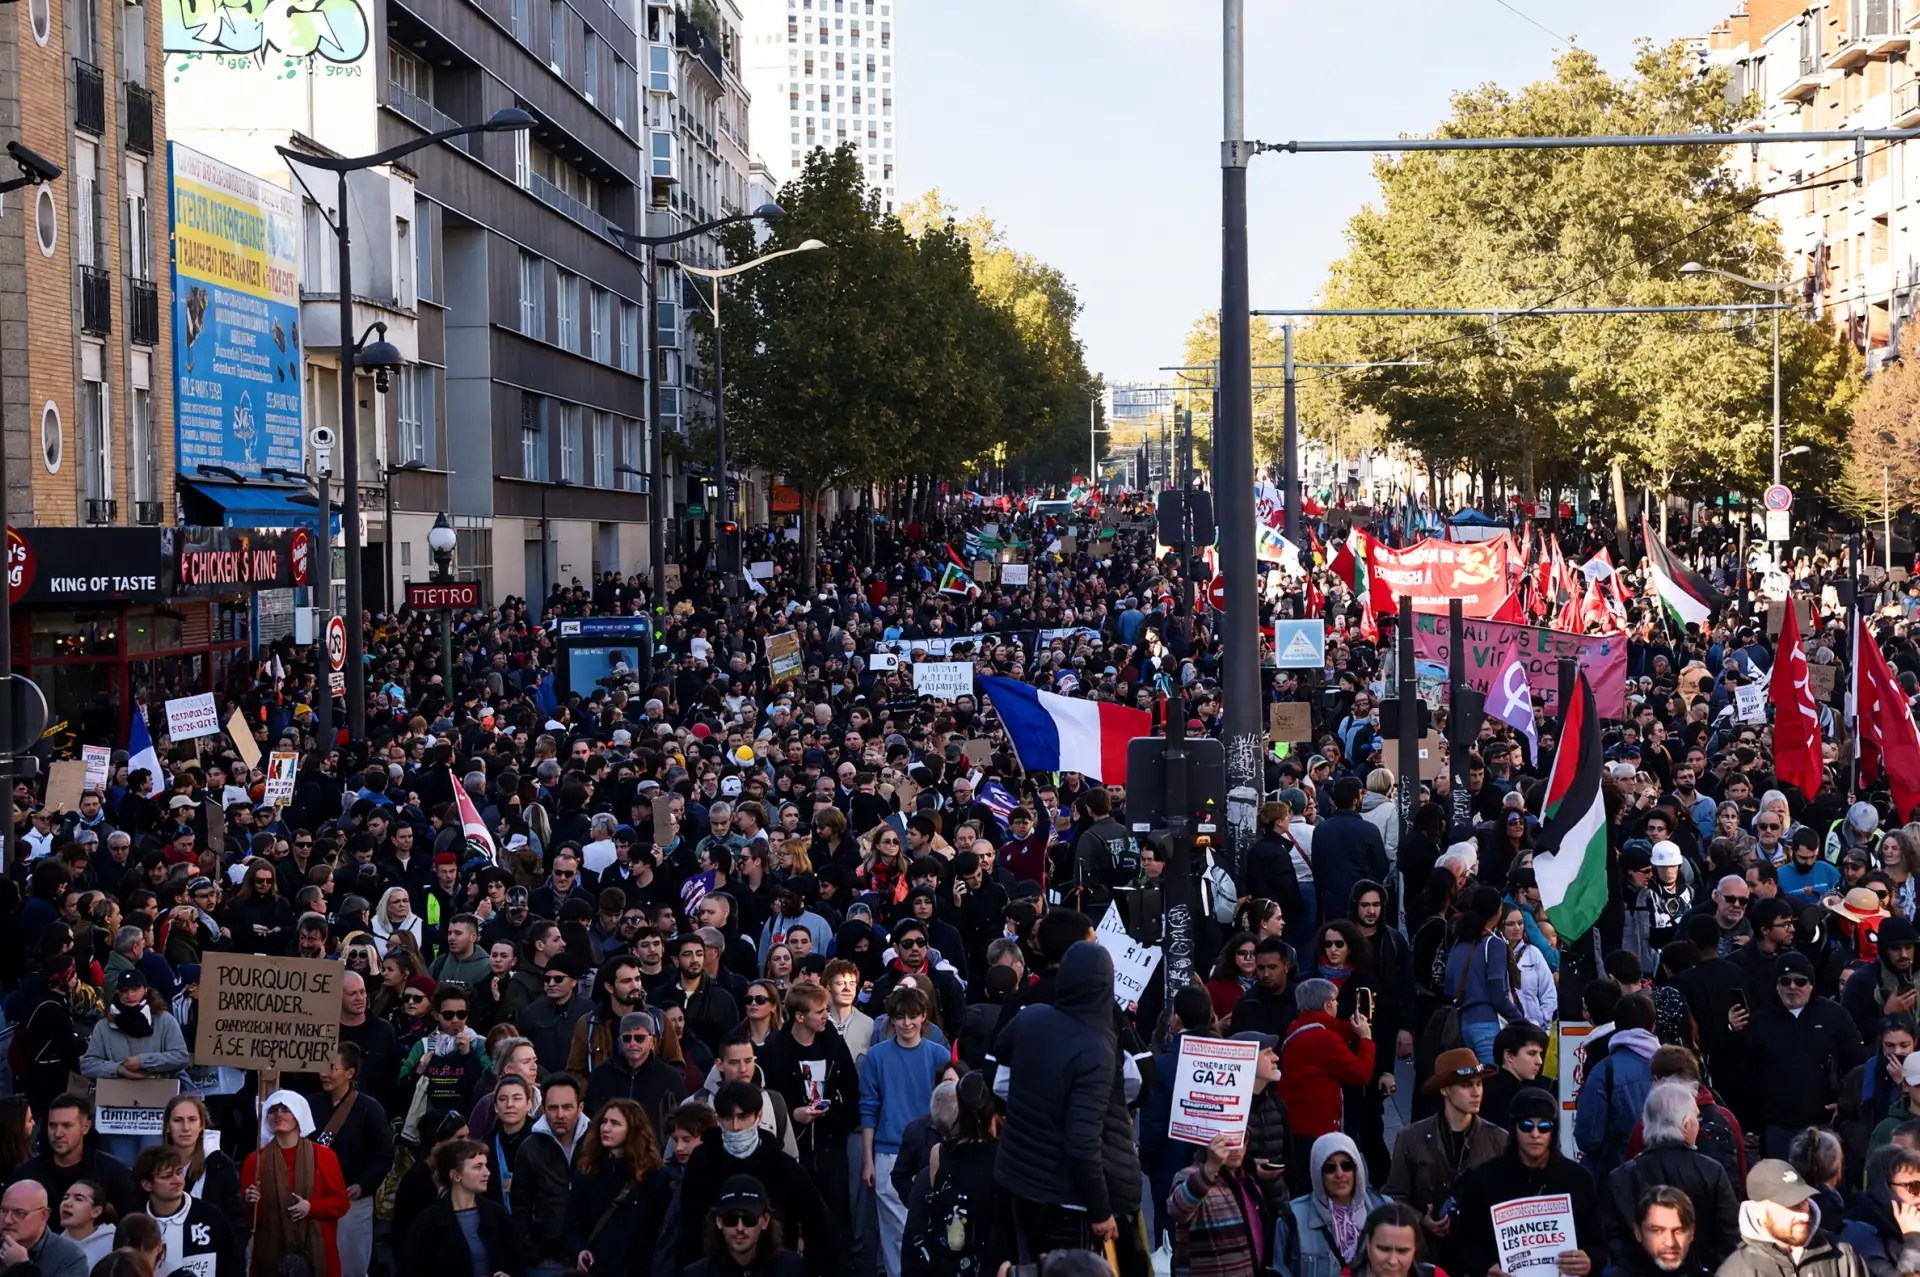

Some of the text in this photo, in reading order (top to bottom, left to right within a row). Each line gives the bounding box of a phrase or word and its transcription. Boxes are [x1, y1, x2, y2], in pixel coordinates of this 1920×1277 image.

[191, 551, 250, 584] CHICKEN'S
[253, 550, 277, 581] KING
[51, 576, 156, 592] KING OF TASTE
[413, 588, 473, 604] METRO
[217, 966, 333, 993] POURQUOI SE
[218, 992, 313, 1016] BARRICADER...
[226, 1037, 245, 1056] SE
[1193, 1070, 1236, 1086] GAZA
[1501, 1220, 1559, 1239] FINANCEZ
[1503, 1237, 1520, 1251] LES
